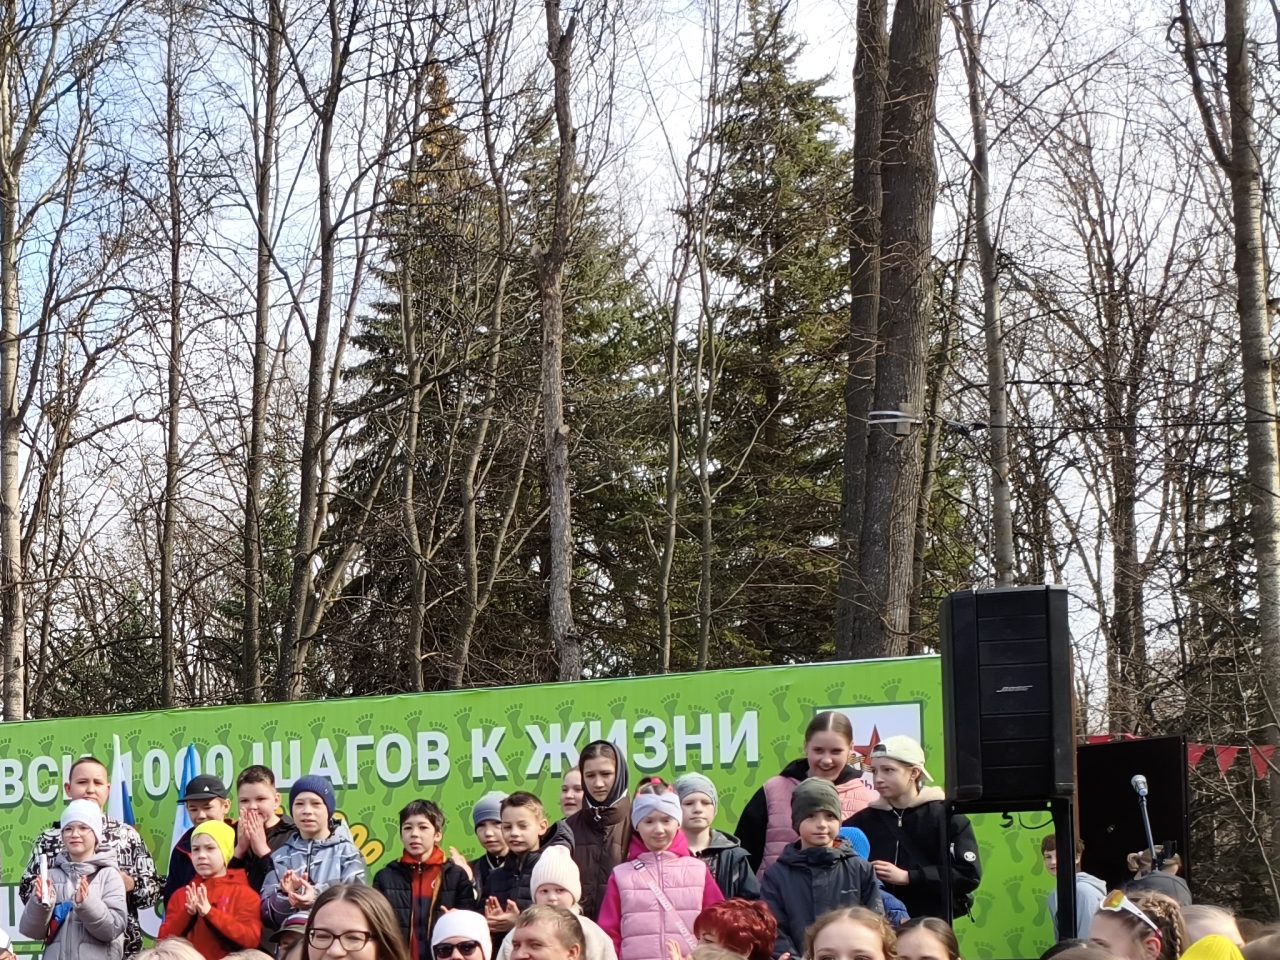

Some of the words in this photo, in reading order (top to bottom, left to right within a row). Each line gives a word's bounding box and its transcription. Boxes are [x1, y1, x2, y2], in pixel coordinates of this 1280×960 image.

[252, 730, 451, 790] ШАГОВ
[471, 726, 508, 782] К
[524, 710, 760, 779] ЖИЗНИ
